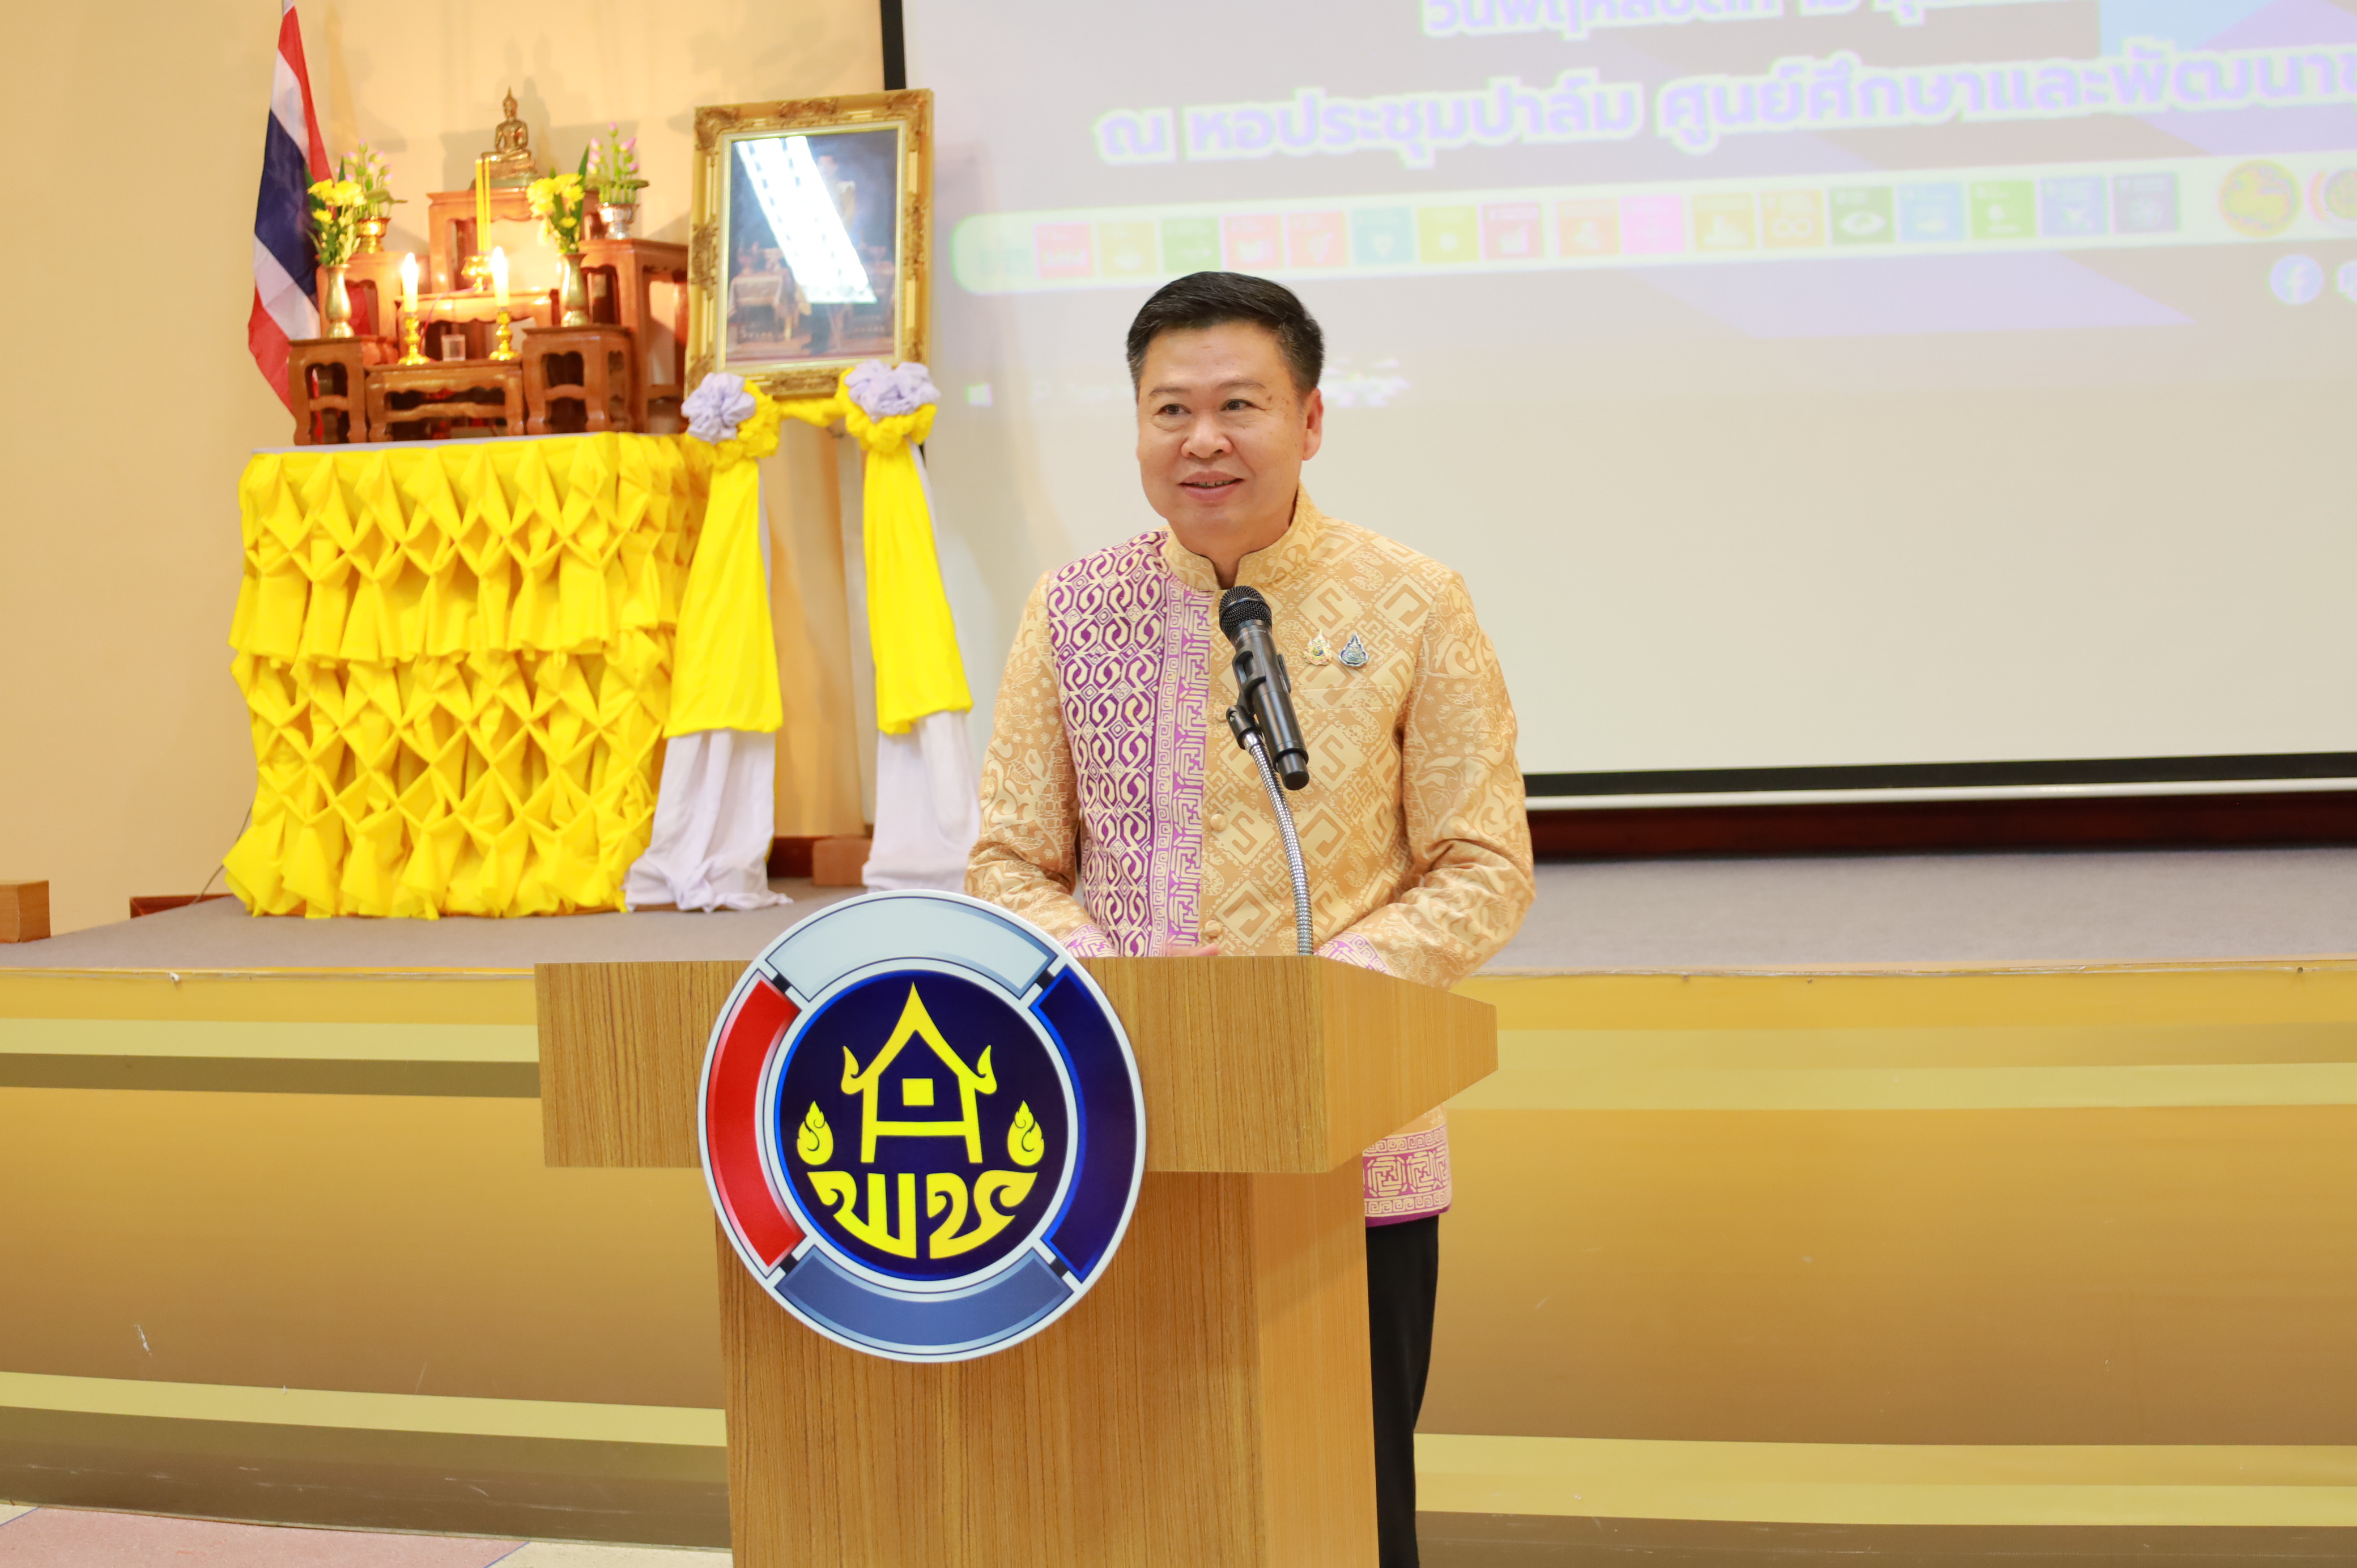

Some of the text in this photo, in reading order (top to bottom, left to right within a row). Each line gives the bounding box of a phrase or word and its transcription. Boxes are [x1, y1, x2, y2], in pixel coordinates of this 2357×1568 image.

[1098, 111, 1171, 160] ณ
[1186, 73, 1639, 164] หอประชุมปาล์ม
